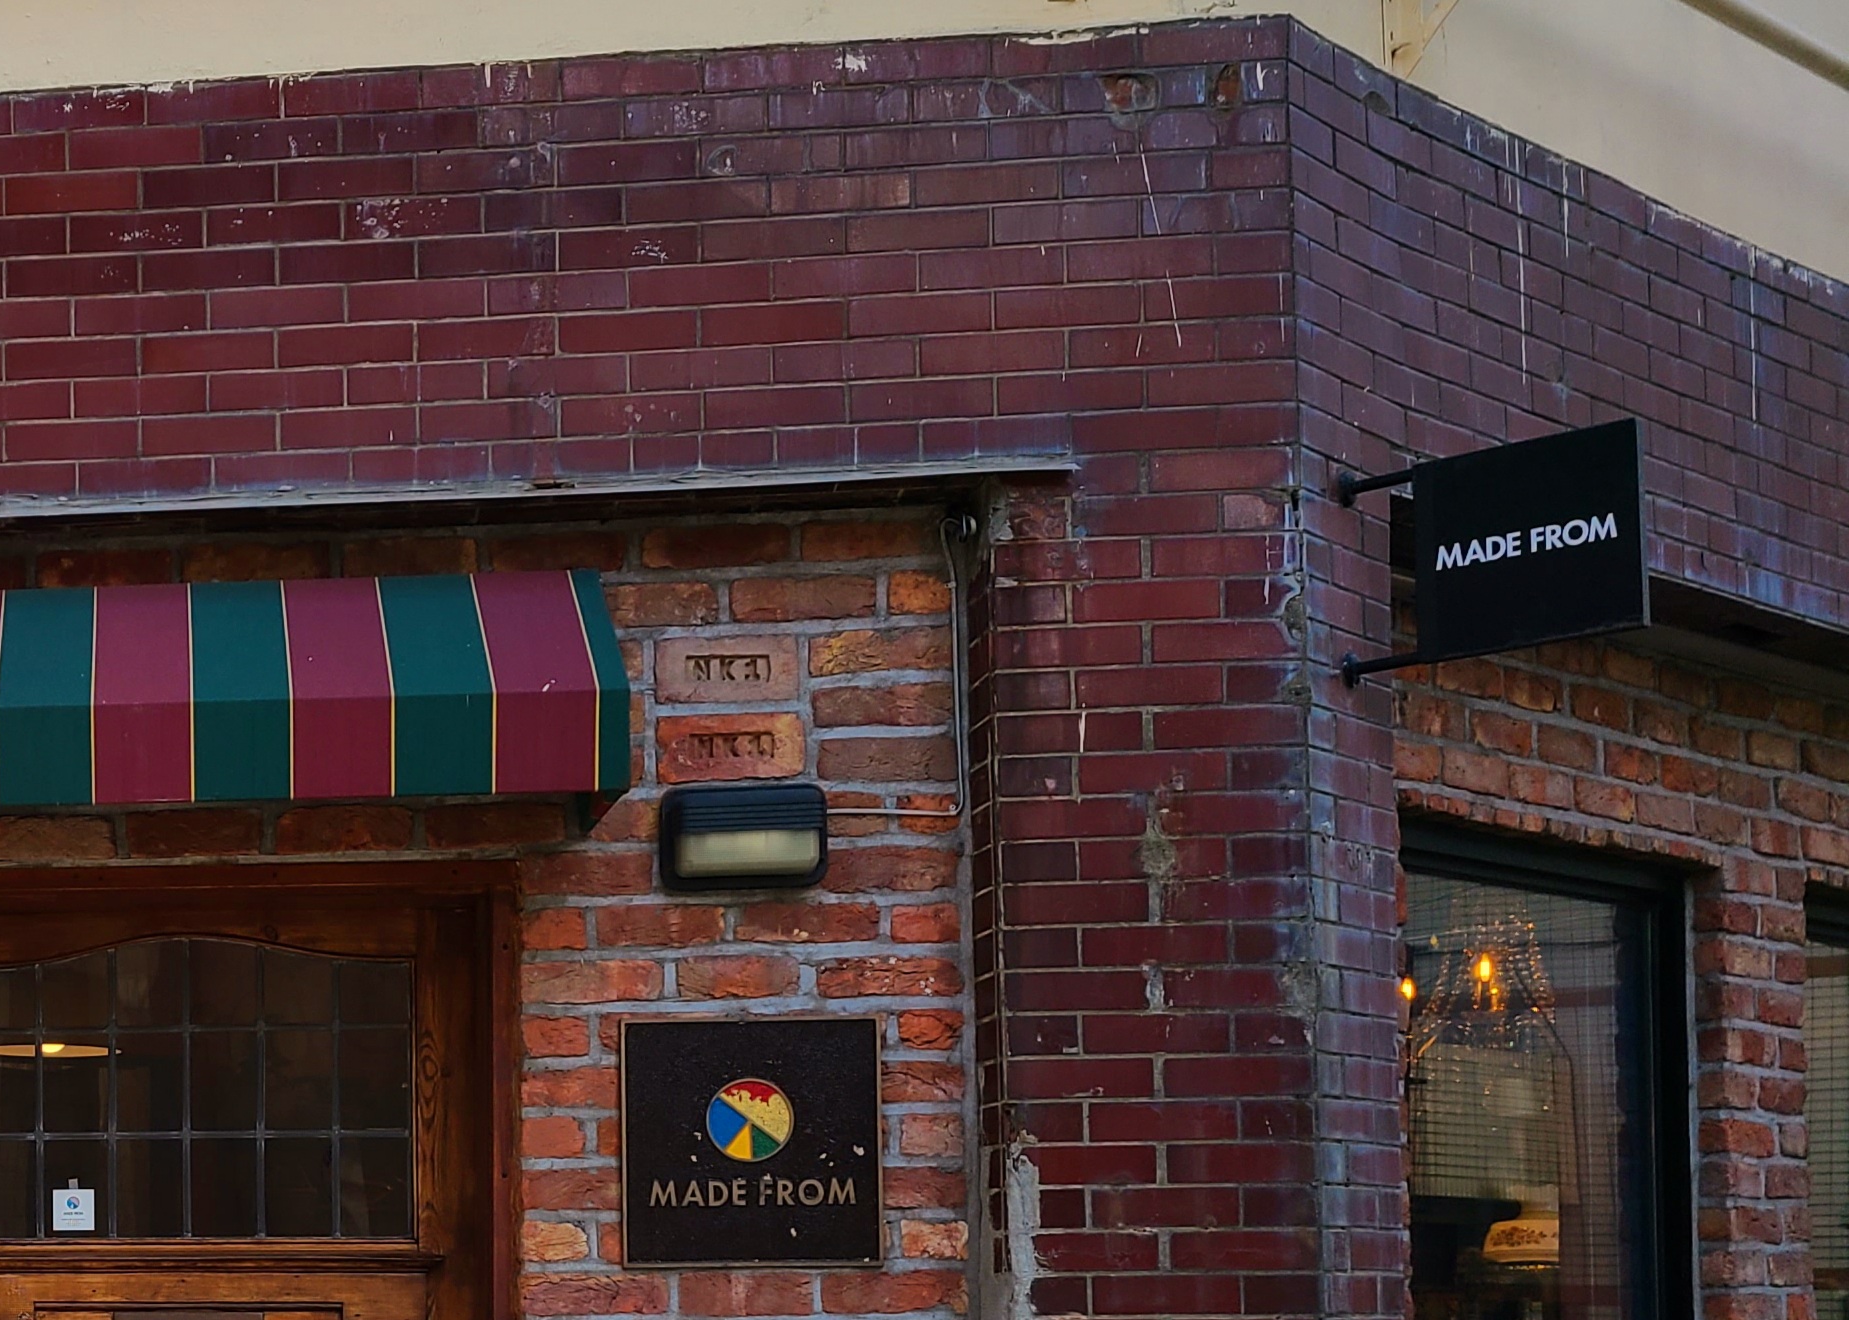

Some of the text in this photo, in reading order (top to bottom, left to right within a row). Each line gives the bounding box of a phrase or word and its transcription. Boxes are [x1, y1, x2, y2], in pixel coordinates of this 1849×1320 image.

[1435, 512, 1618, 571] MADE FROM
[649, 1176, 857, 1207] MADE FROM
